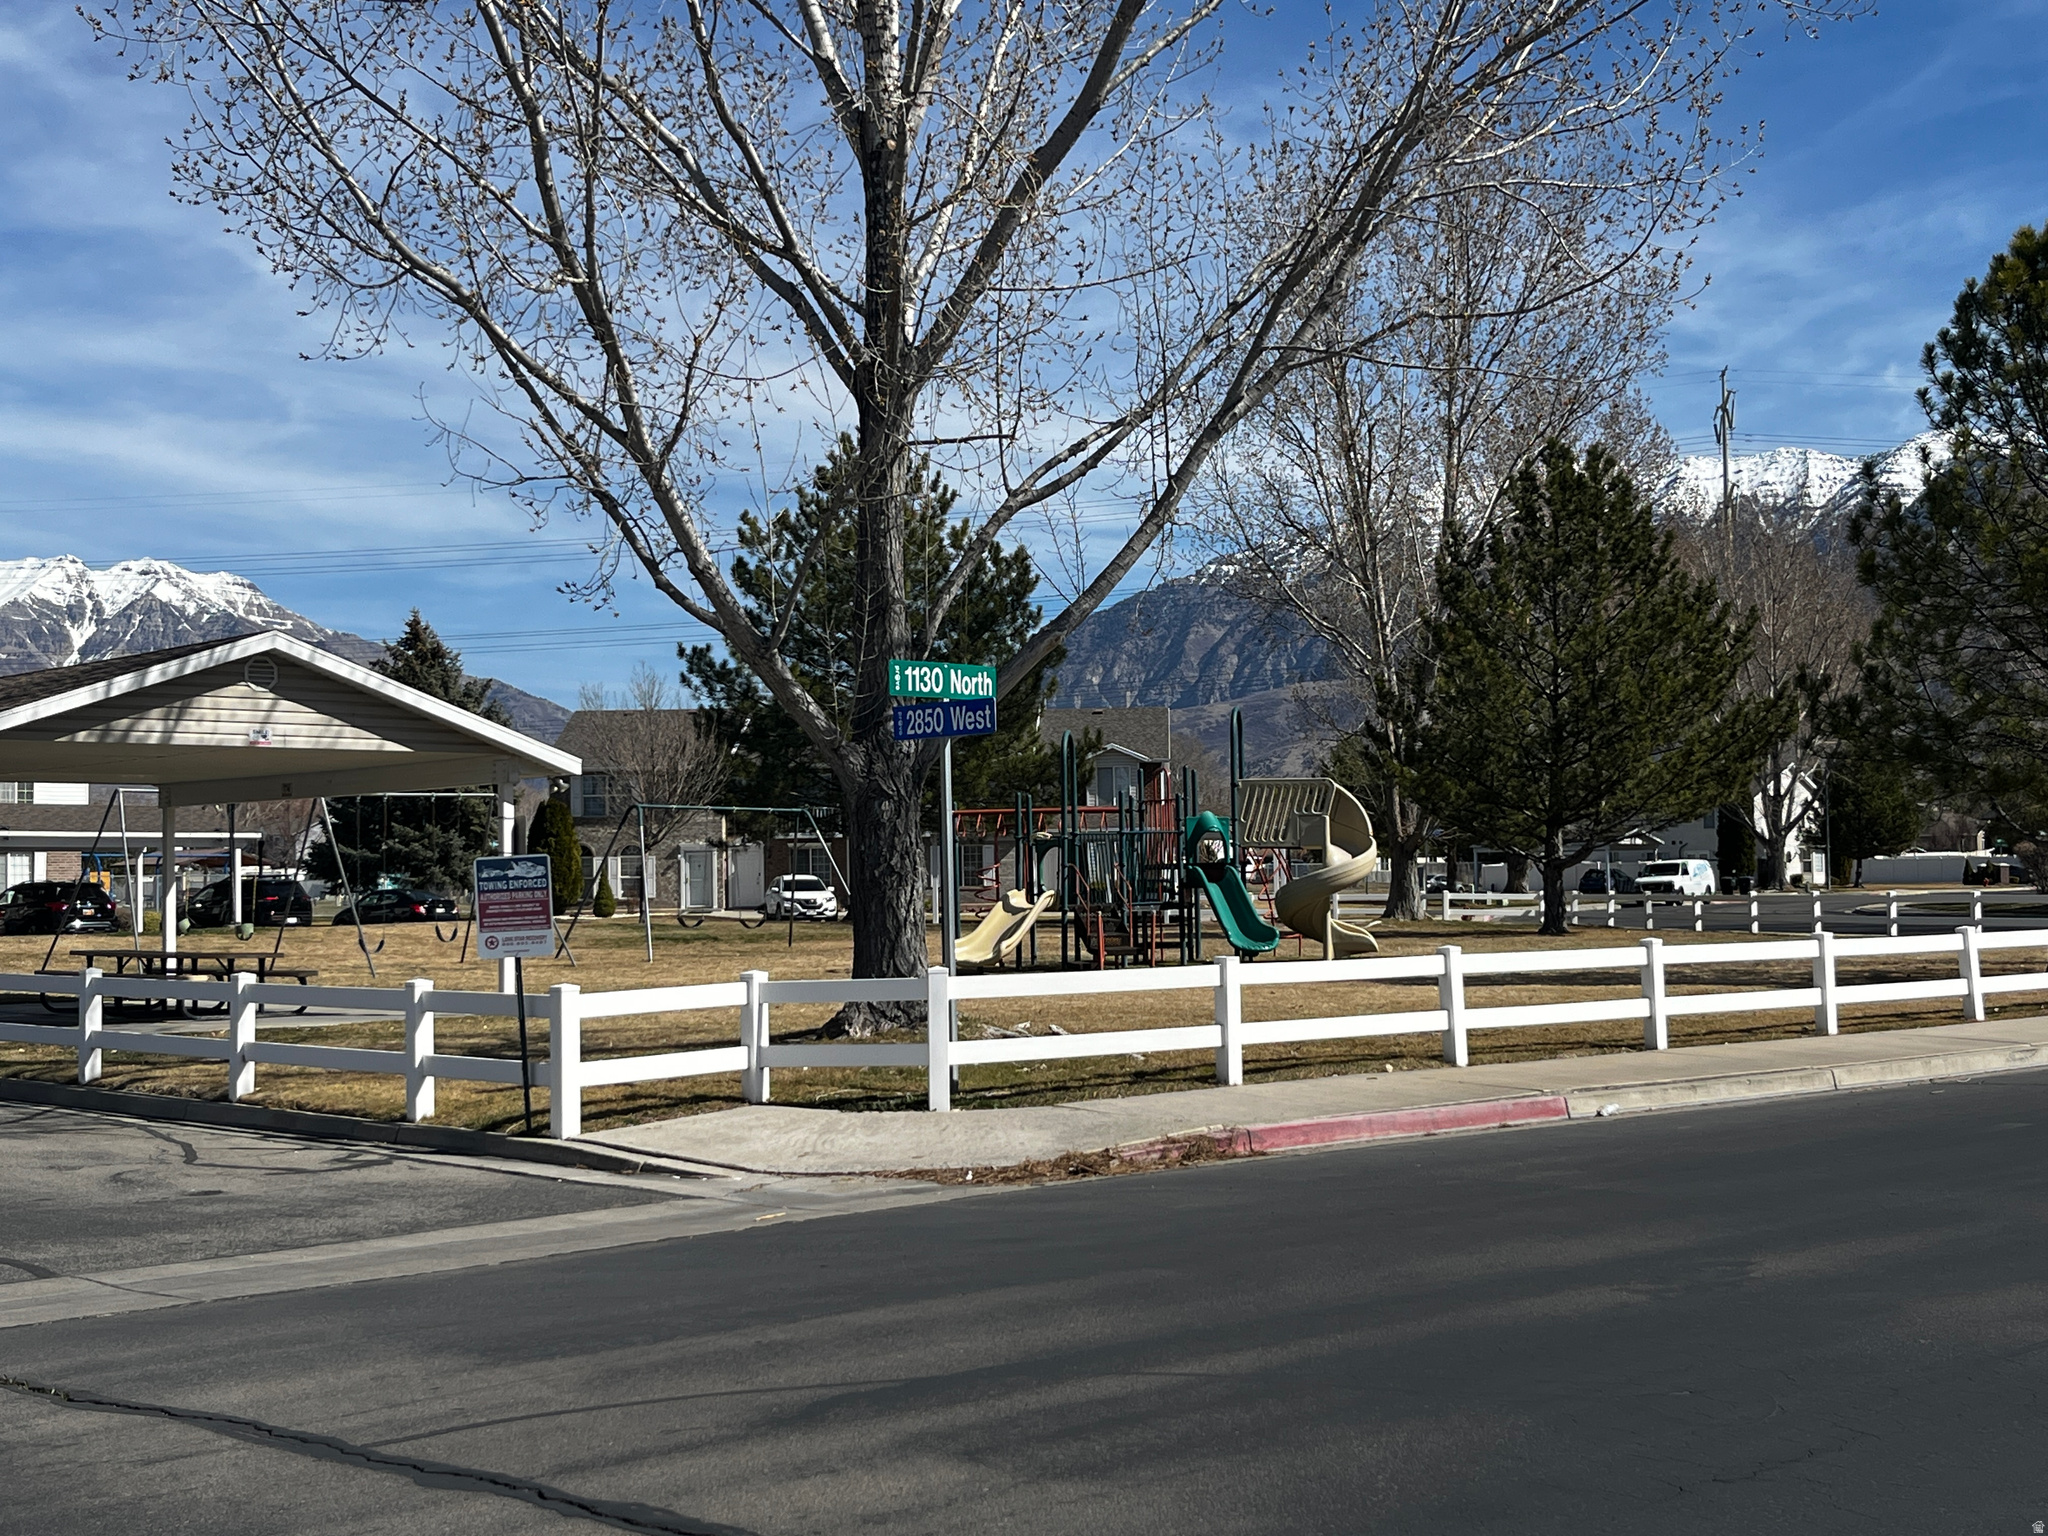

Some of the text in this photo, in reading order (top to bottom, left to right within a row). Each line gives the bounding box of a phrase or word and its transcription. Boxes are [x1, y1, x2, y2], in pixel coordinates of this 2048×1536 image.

[905, 666, 992, 696] 1130 North
[906, 704, 991, 735] 2850 West
[479, 879, 547, 890] TOWING ENFORCED
[512, 891, 533, 899] PARKING
[534, 890, 547, 898] ONLY
